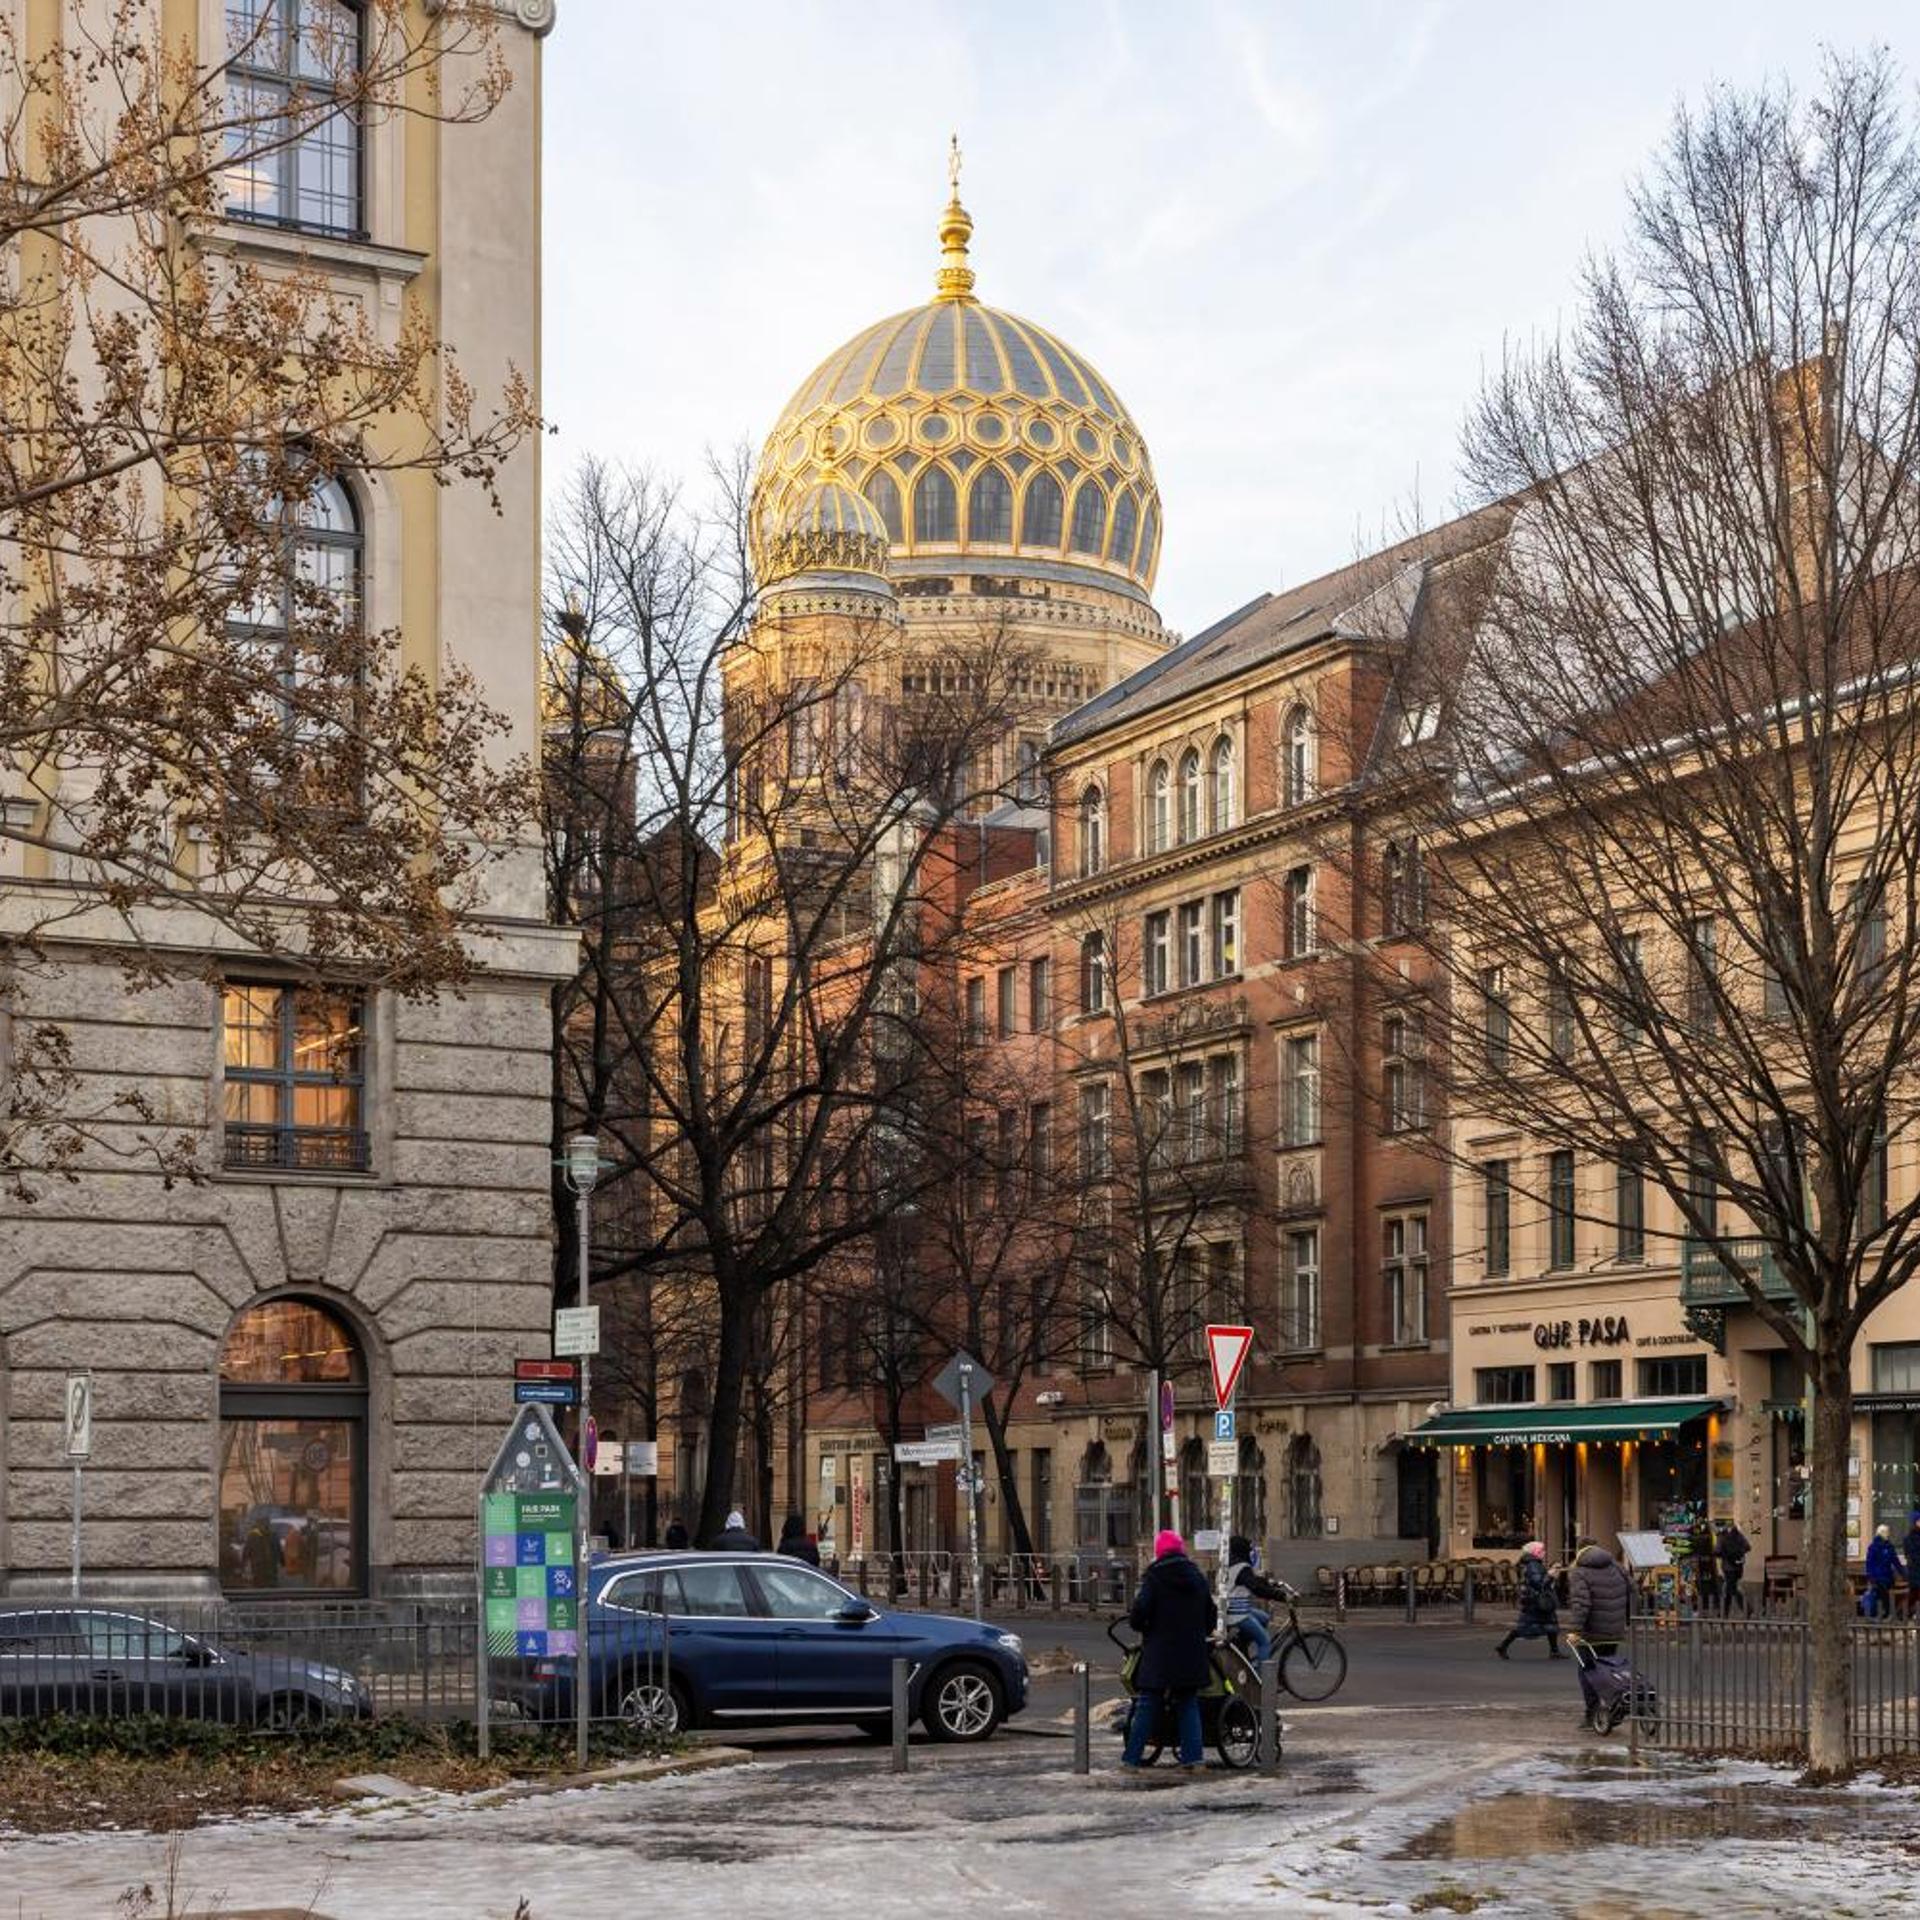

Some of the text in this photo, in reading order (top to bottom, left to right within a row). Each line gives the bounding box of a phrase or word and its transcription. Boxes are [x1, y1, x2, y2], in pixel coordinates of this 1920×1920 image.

[1534, 1316, 1630, 1350] QUE PASA
[1494, 1432, 1571, 1445] CANTINA MEXICANA
